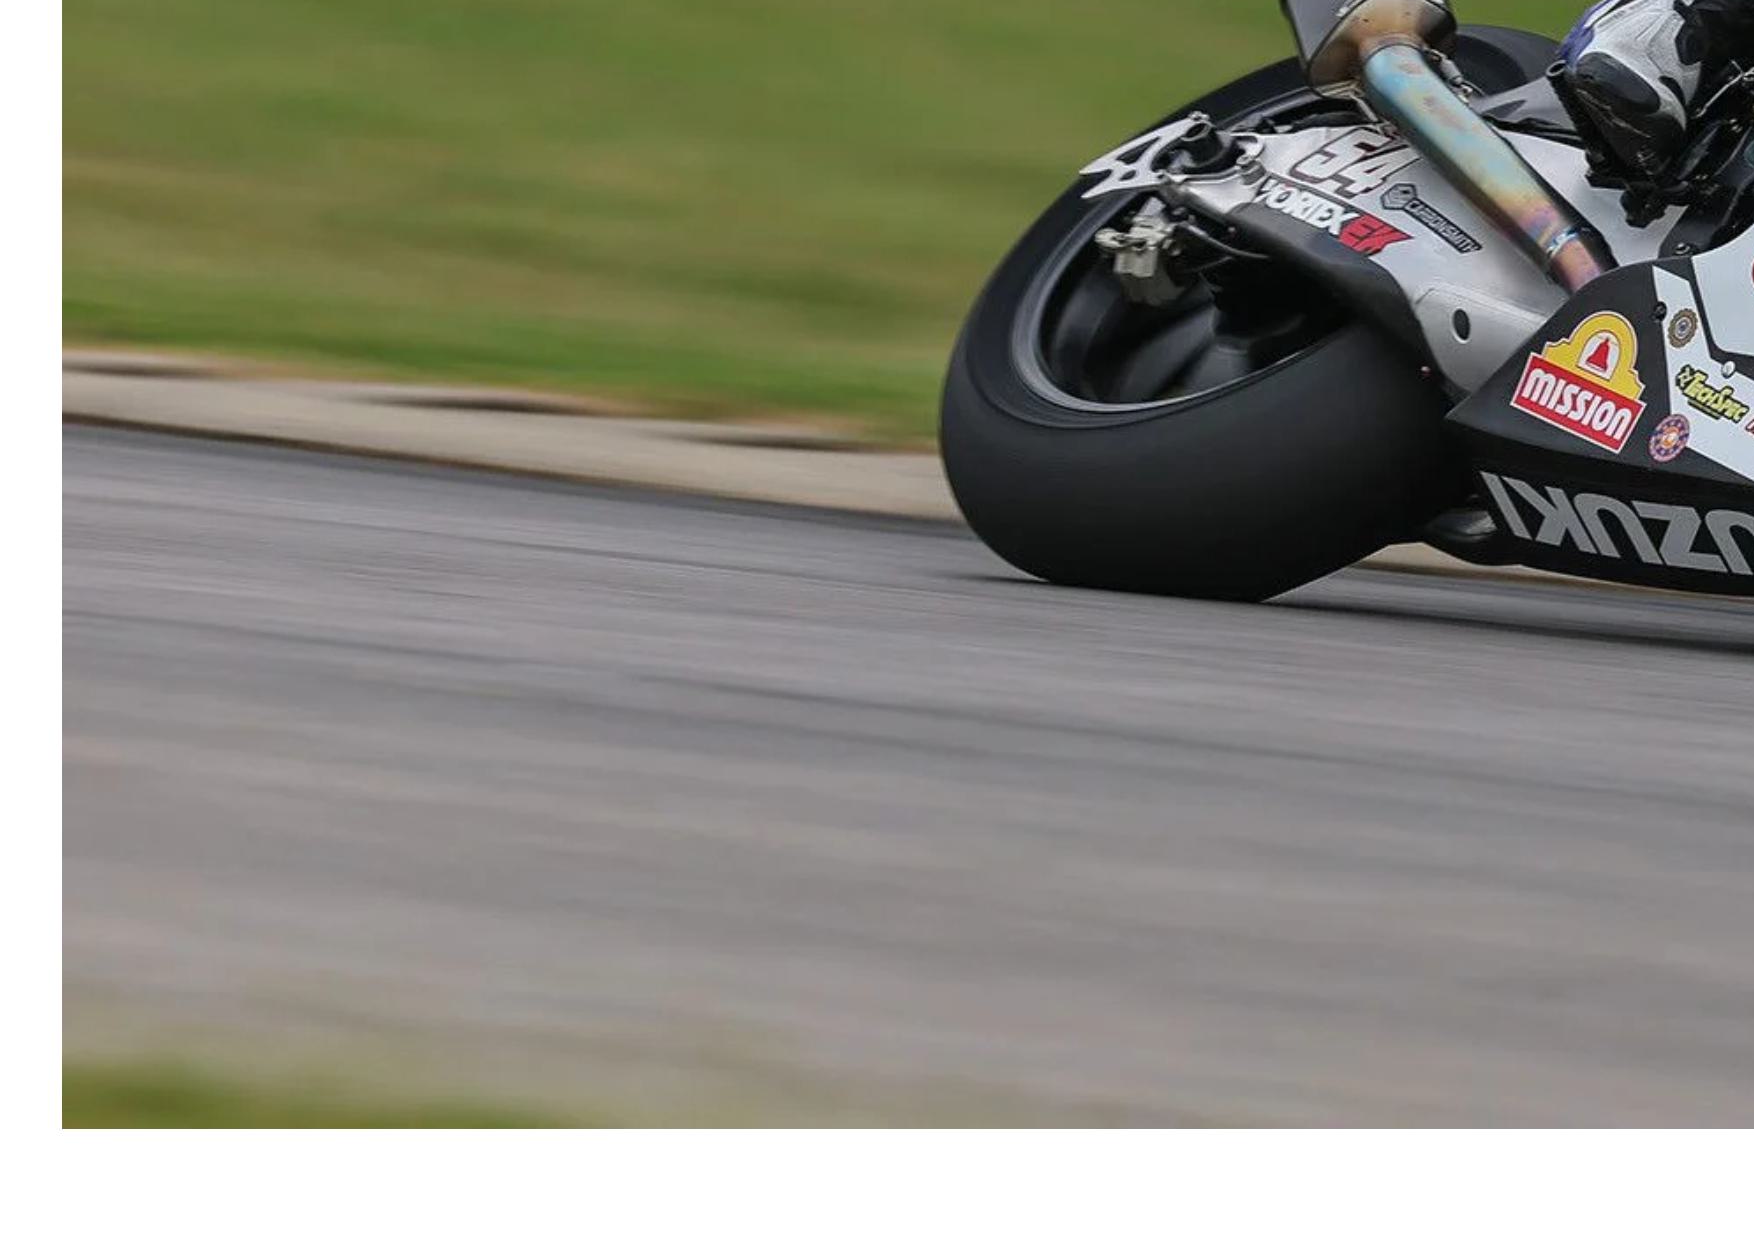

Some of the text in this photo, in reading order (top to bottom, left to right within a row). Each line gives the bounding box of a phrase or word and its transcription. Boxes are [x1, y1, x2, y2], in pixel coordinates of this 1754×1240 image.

[1290, 126, 1422, 199] 54
[1252, 178, 1361, 236] VORTEX
[1521, 367, 1633, 442] MISSION
